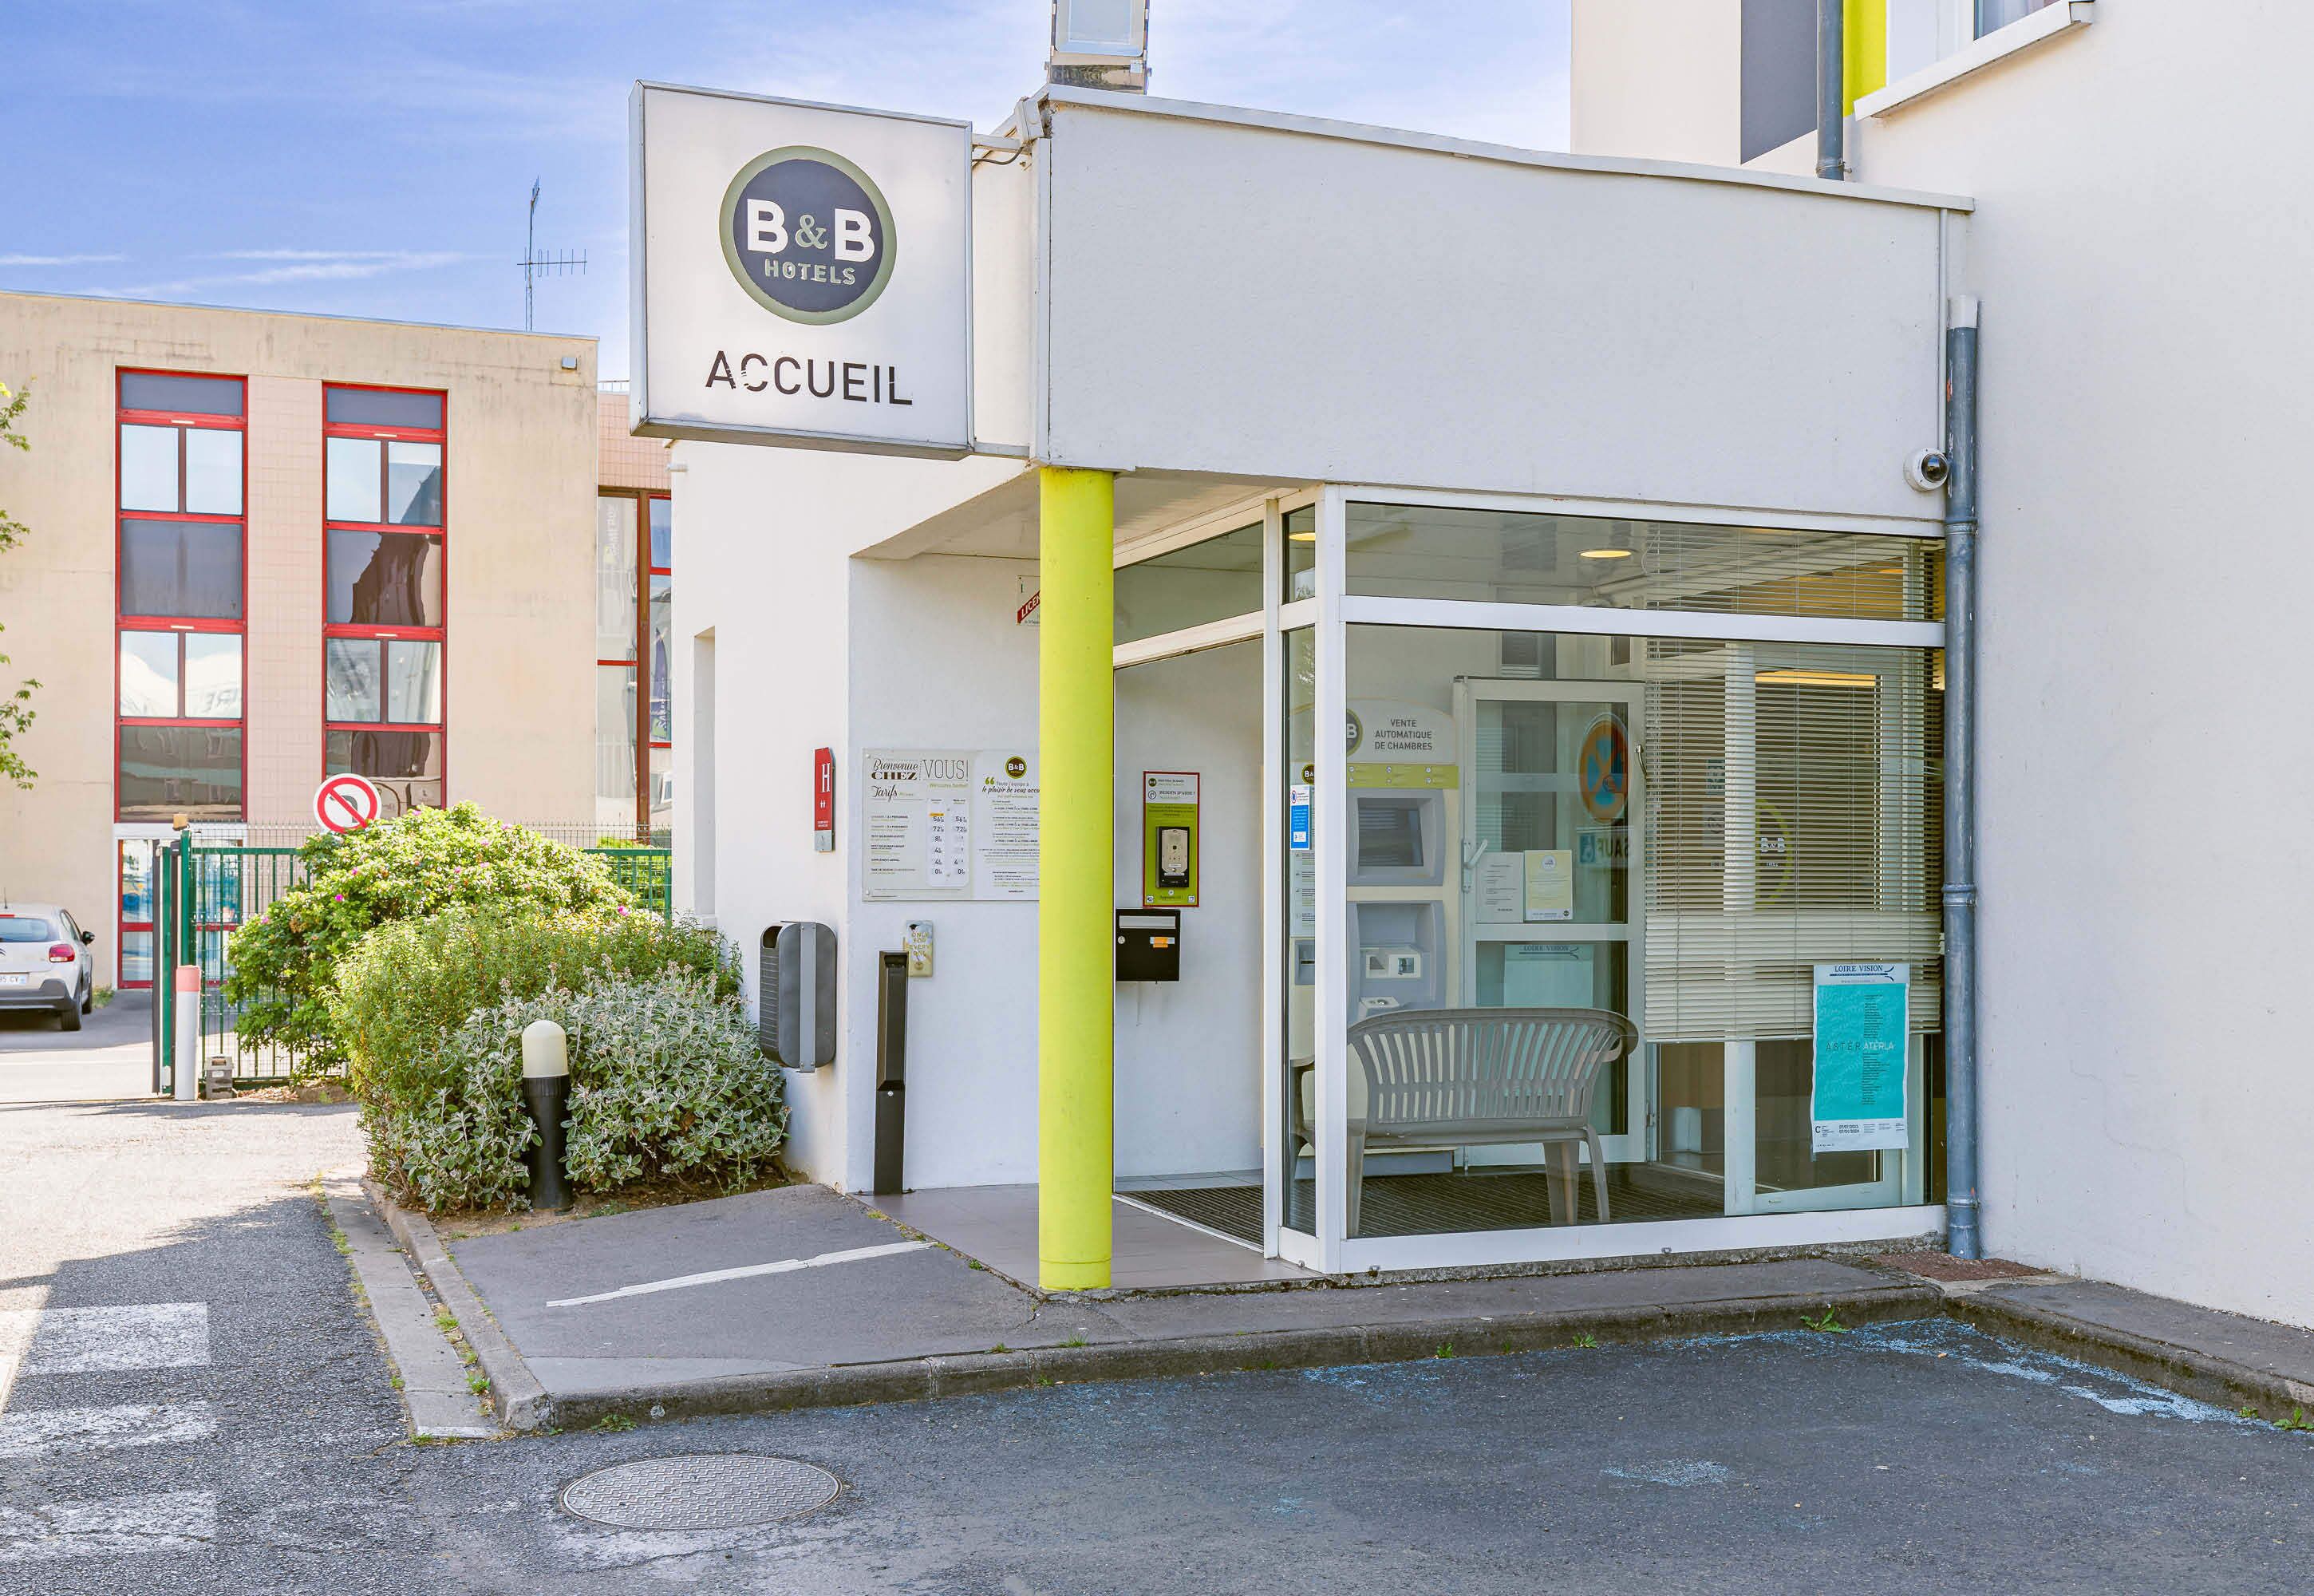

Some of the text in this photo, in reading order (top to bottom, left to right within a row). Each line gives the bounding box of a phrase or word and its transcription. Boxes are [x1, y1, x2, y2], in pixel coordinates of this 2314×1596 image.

[764, 258, 856, 286] HOTELS
[705, 350, 914, 406] ACCUEIL
[1390, 718, 1417, 728] VENTE
[1375, 730, 1432, 739] AUTOMATIQUE
[1374, 741, 1433, 751] DE CHAMBRES
[872, 757, 919, 772] Bienvenue
[821, 762, 831, 793] H
[871, 771, 918, 780] CHEZ
[871, 784, 898, 803] Tarifs
[988, 785, 1006, 796] plaisir
